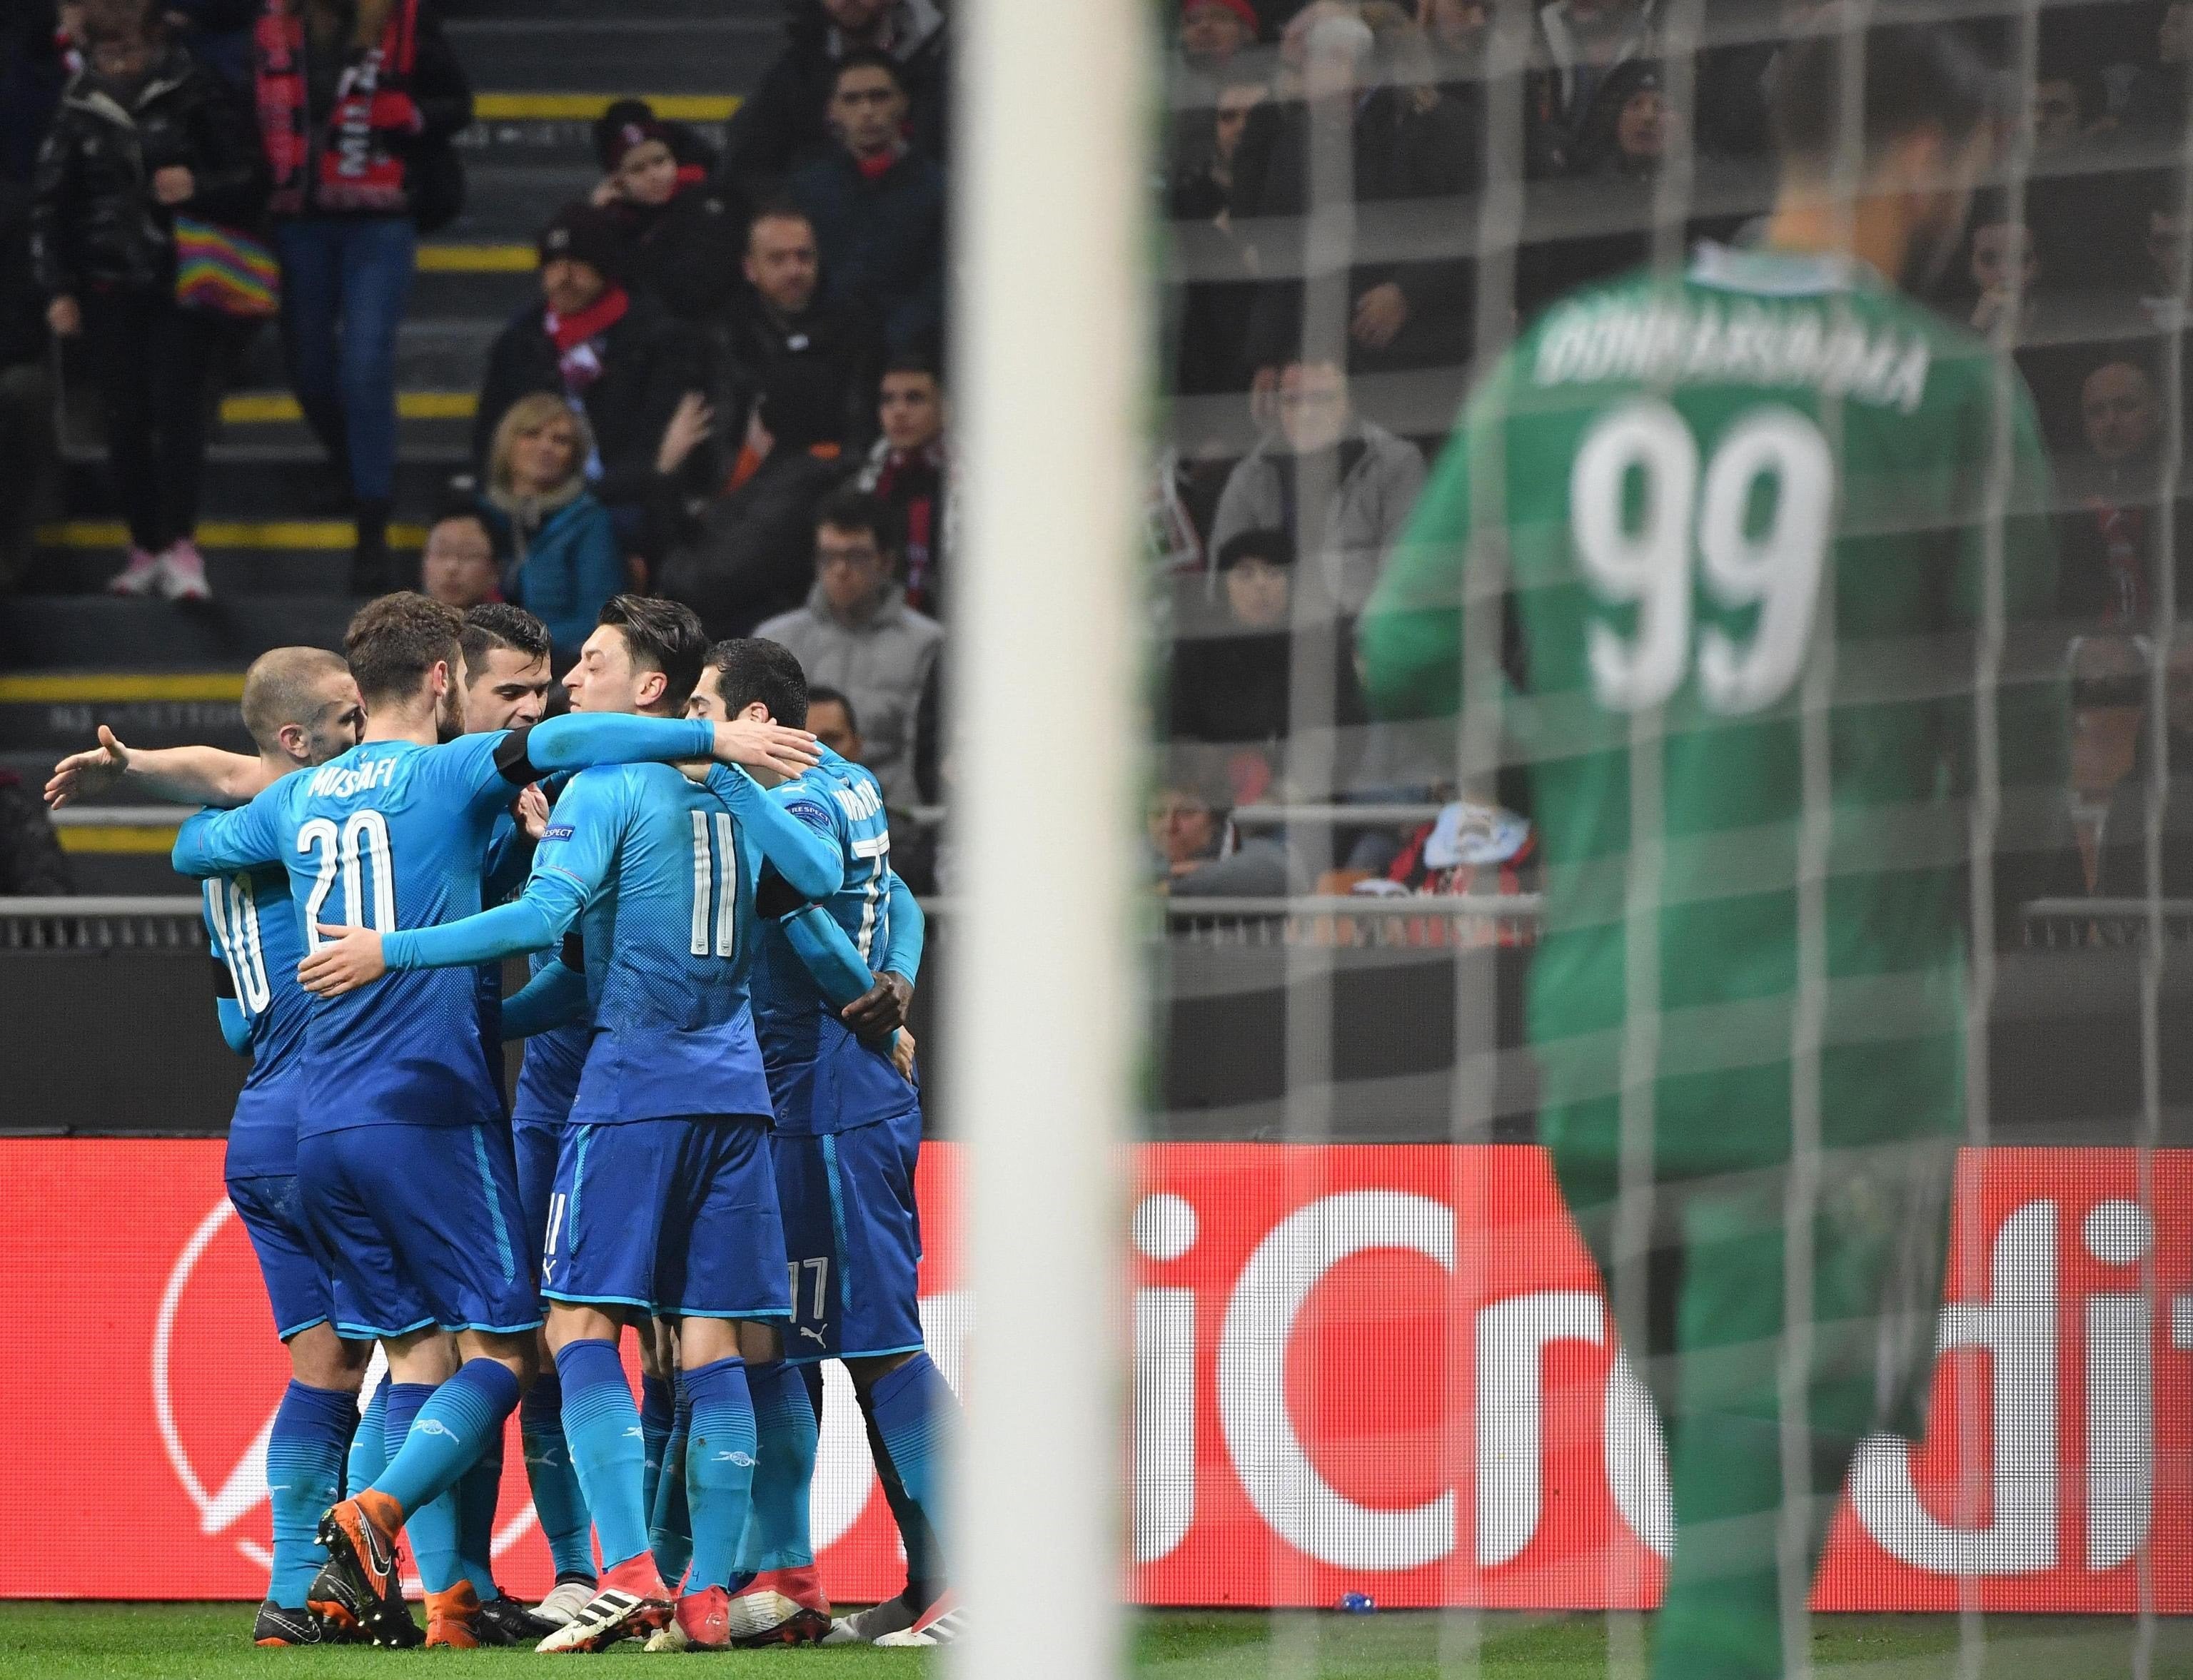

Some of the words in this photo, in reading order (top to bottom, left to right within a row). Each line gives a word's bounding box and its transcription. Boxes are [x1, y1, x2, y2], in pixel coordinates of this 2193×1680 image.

[1573, 398, 1835, 714] 99
[307, 752, 398, 799] MUSAFI
[208, 872, 271, 1018] 10
[297, 809, 395, 956] 20
[690, 810, 736, 957] 11
